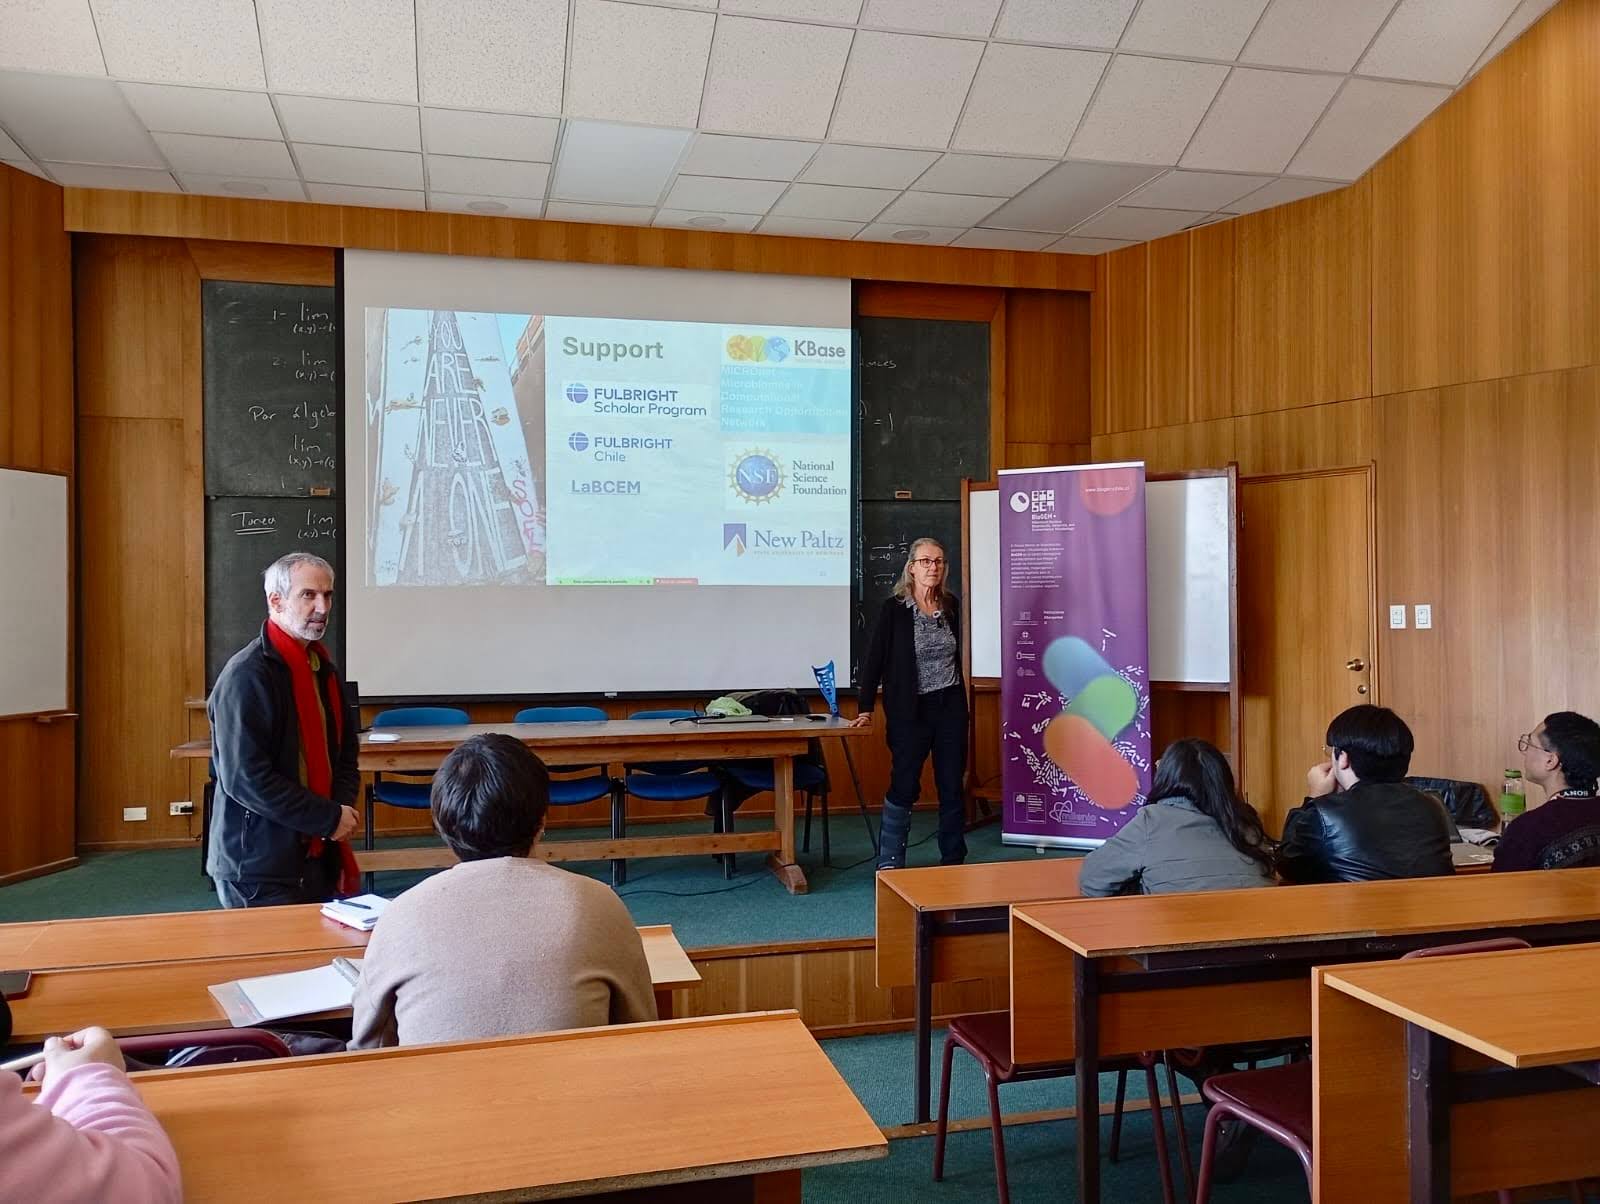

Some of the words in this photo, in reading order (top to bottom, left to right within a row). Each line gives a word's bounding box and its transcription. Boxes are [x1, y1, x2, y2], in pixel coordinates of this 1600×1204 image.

[301, 302, 329, 321] lim
[431, 320, 463, 351] YOU
[562, 336, 664, 362] Support
[794, 339, 846, 358] KBase
[302, 349, 327, 366] lim
[424, 352, 479, 396] ARE
[594, 387, 678, 402] FULBRIGHT
[248, 405, 276, 421] Por
[594, 401, 645, 414] Scholar
[649, 402, 707, 418] Program
[294, 434, 321, 452] lim
[594, 436, 673, 449] FULBRIGHT
[594, 451, 626, 463] Chile
[792, 459, 835, 472] National
[738, 468, 777, 485] NSF
[792, 472, 828, 484] Science
[572, 480, 641, 493] LaBCEM
[792, 484, 847, 496] Foundation
[307, 508, 333, 526] lim
[754, 530, 800, 548] New
[801, 530, 845, 549] Paltz
